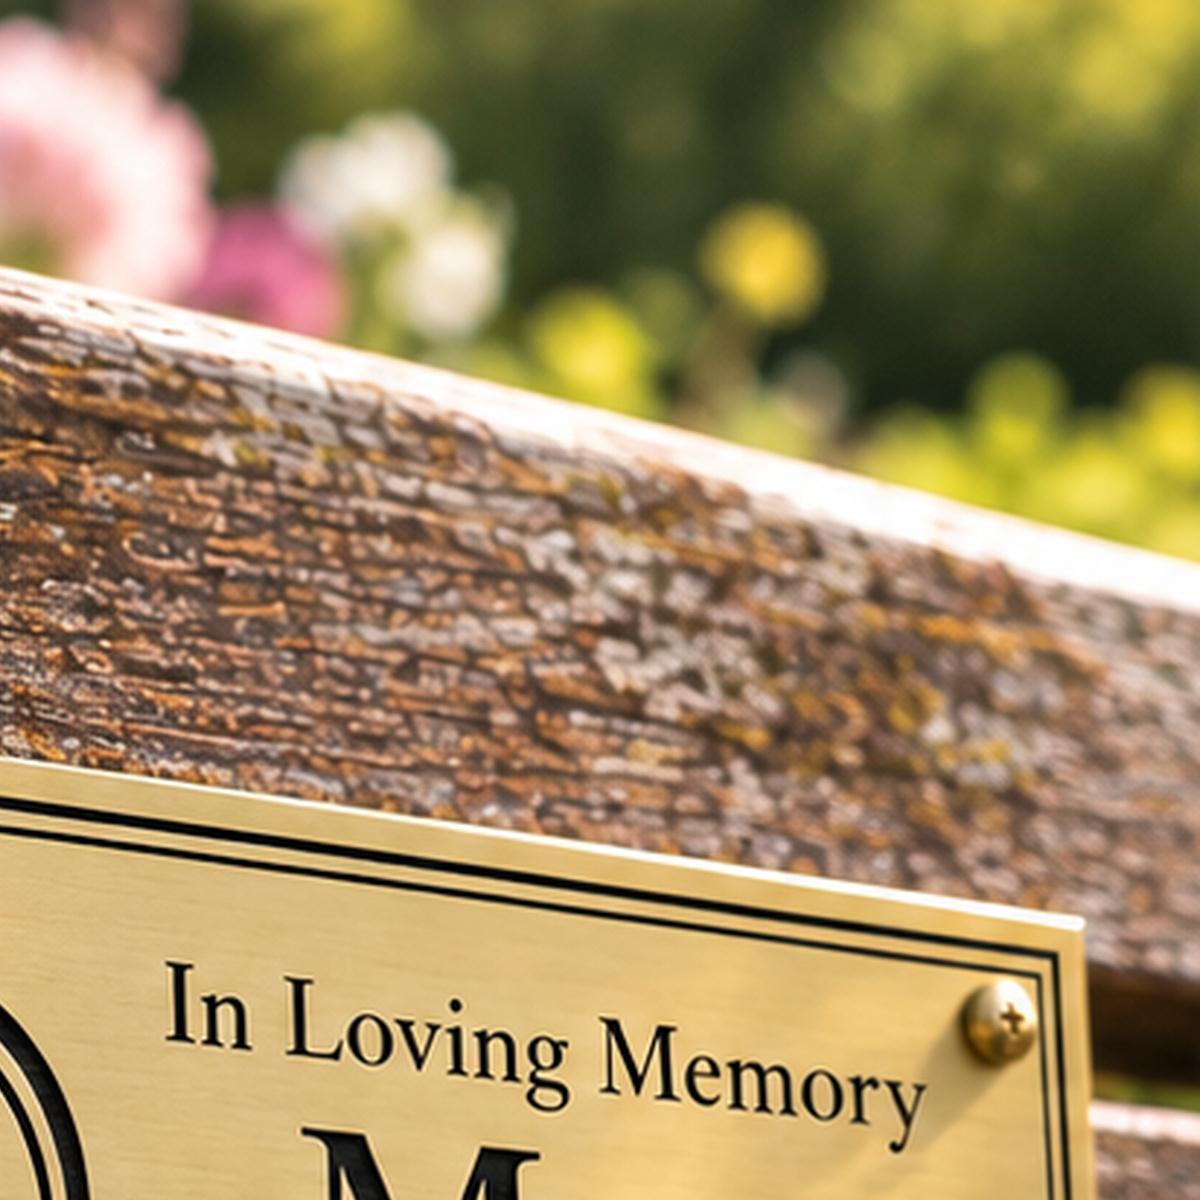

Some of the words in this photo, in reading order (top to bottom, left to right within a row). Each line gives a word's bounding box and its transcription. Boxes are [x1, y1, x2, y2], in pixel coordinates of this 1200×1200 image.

[165, 961, 253, 1052] In
[284, 975, 570, 1113] Loving
[598, 1016, 928, 1155] Memory
